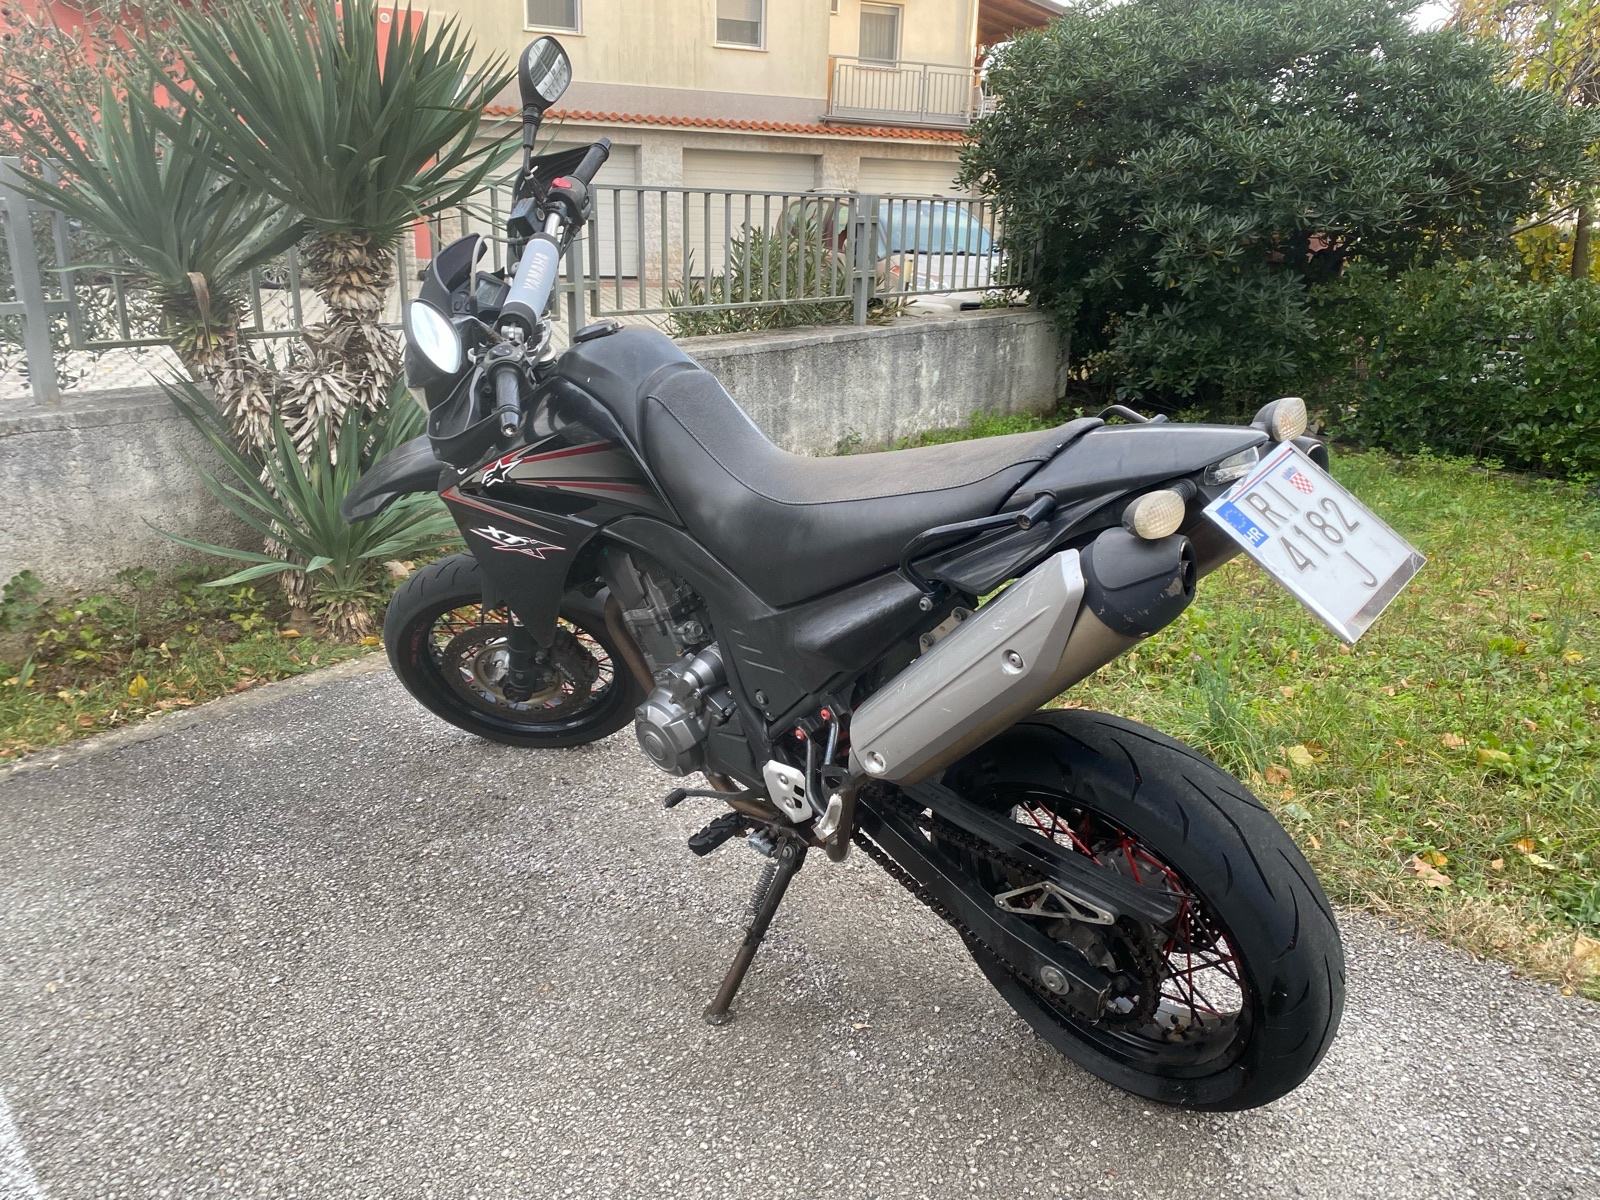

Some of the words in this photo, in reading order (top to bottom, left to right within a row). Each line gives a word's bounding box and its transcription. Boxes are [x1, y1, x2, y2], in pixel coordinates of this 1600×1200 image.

[523, 252, 548, 290] YAMAHA
[1245, 481, 1298, 529] RI
[1243, 525, 1264, 545] HR
[1279, 497, 1360, 572] 4182
[1343, 551, 1378, 588] J
